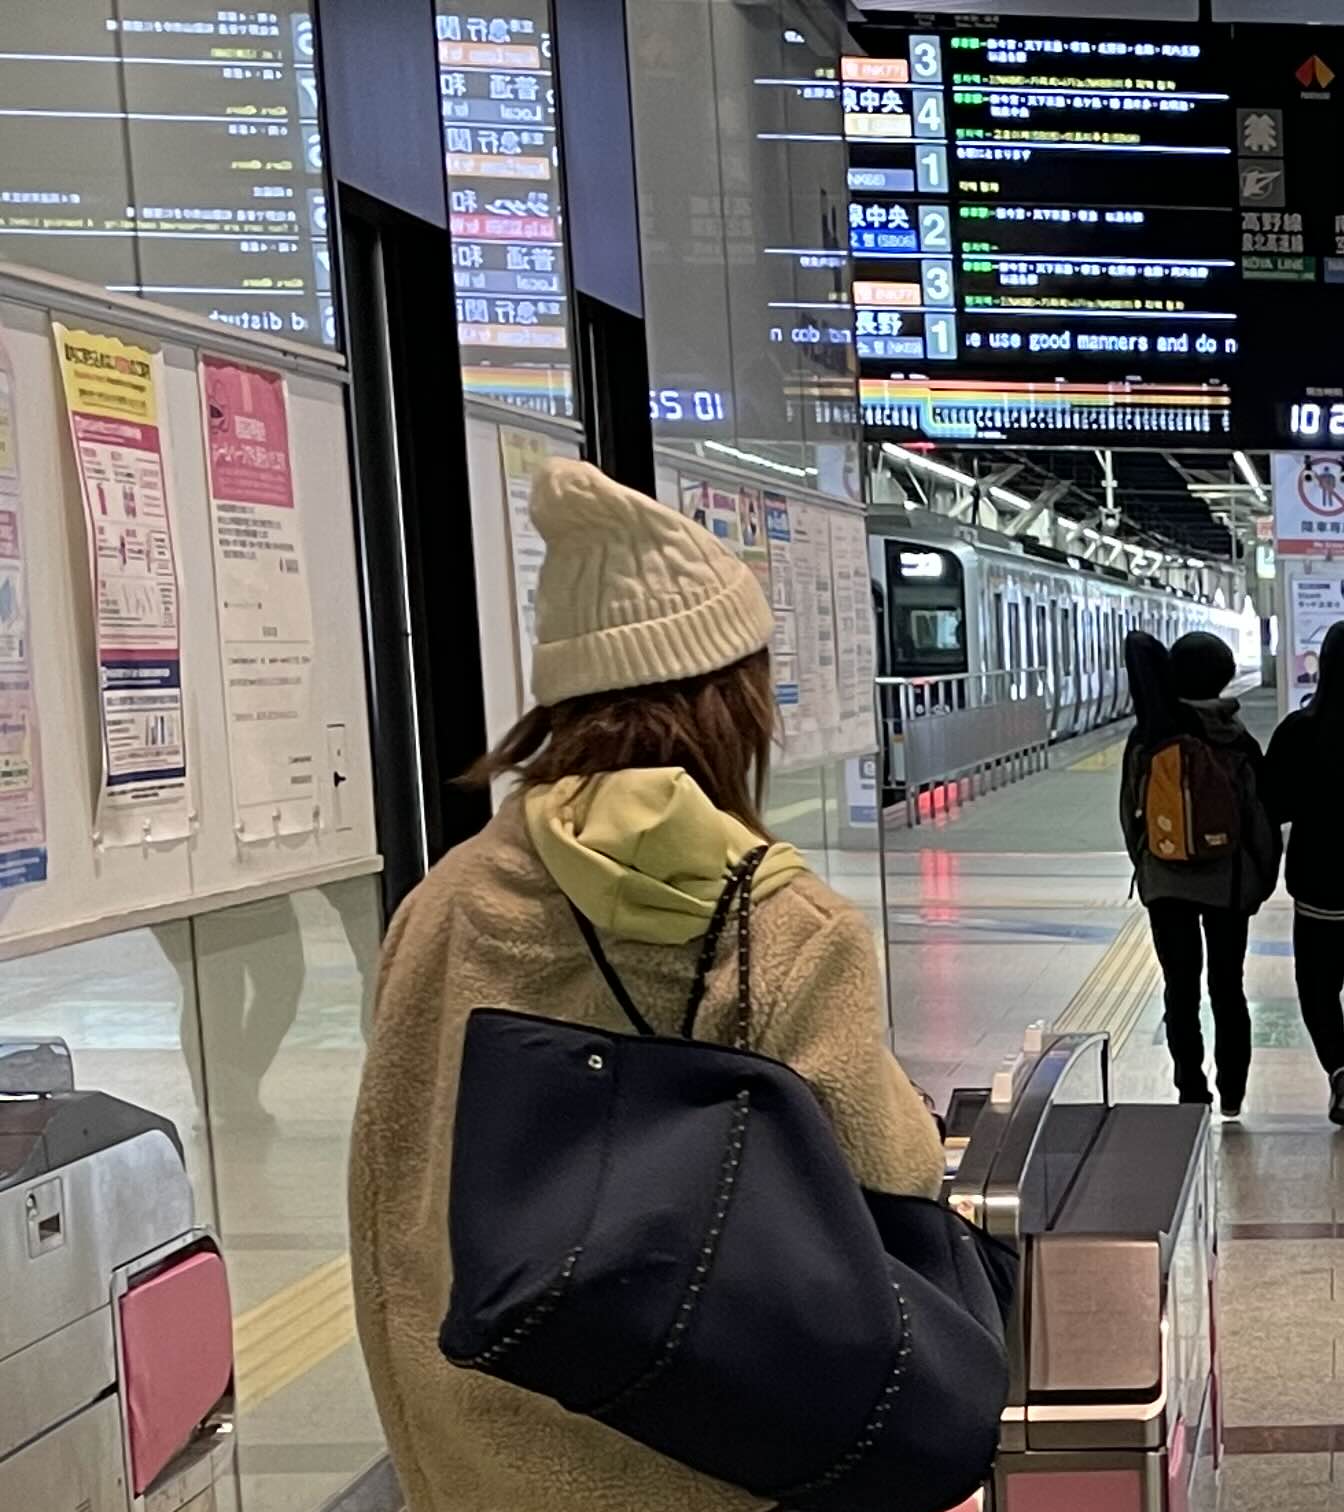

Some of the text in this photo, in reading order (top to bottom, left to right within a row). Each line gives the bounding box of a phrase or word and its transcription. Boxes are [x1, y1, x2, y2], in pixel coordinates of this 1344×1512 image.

[914, 42, 937, 76] 3
[917, 97, 940, 131] 4
[921, 153, 939, 186] 1
[922, 213, 946, 246] 2
[926, 267, 949, 300] 3
[931, 320, 946, 353] 1
[989, 333, 1021, 349] use
[1029, 331, 1070, 351] good
[1078, 334, 1148, 352] manners
[1157, 334, 1189, 353] and
[1196, 335, 1217, 353] do
